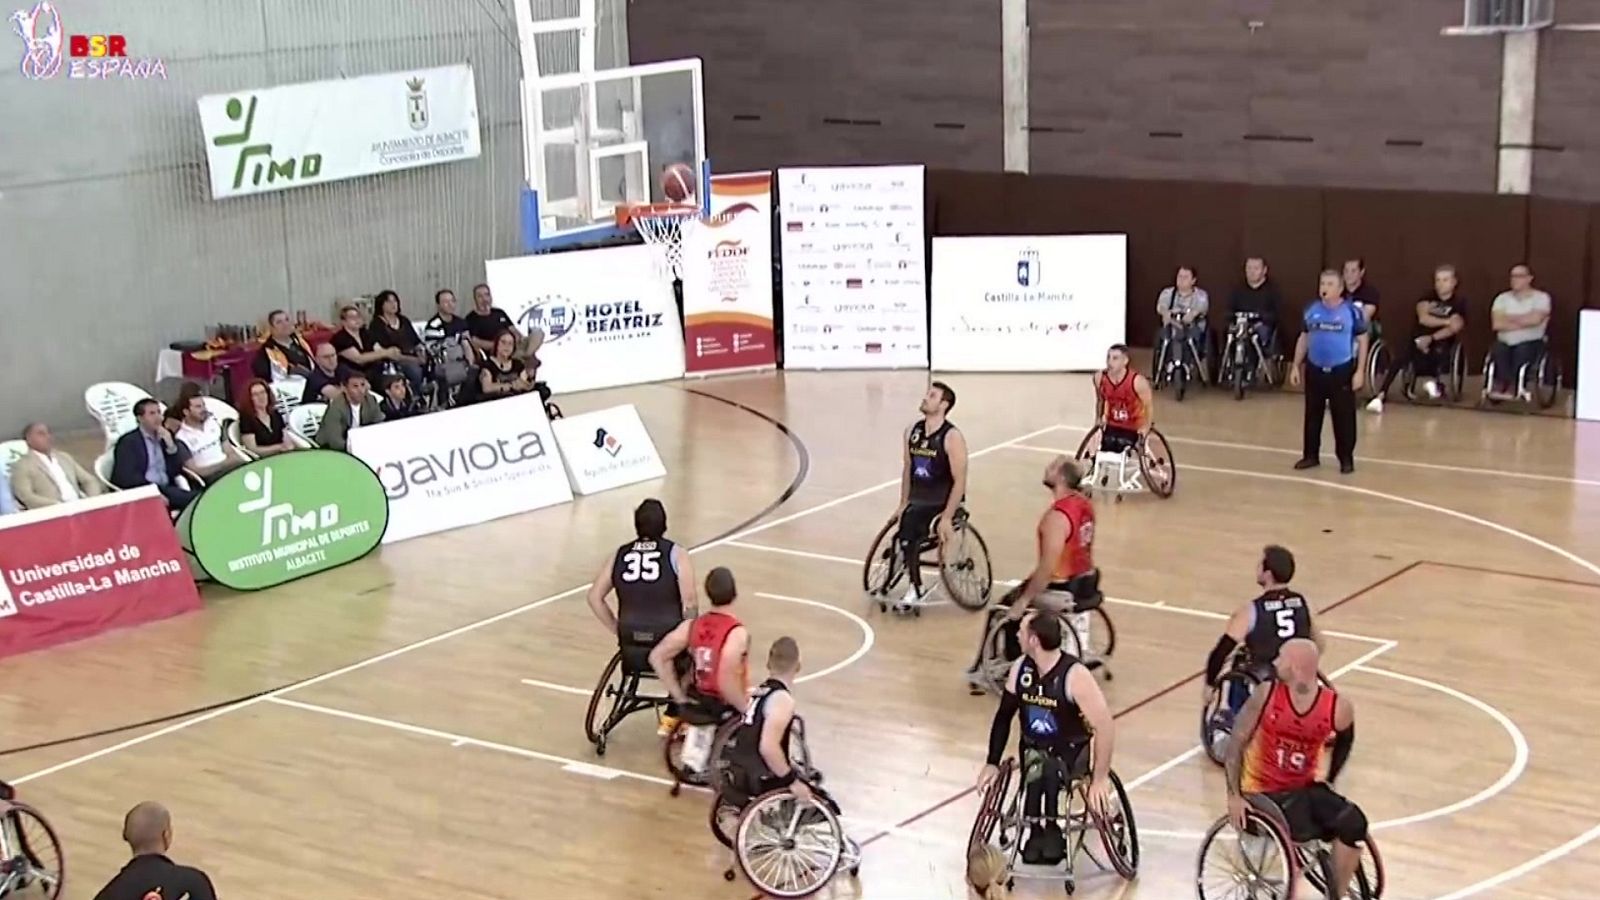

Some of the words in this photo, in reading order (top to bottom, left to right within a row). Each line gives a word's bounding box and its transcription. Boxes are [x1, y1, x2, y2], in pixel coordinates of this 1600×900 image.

[585, 300, 643, 319] HOTEL
[586, 312, 664, 335] BEATRIZ
[385, 431, 546, 500] gaviota
[228, 550, 274, 572] INSTITUTO
[272, 536, 319, 561] MUNICIPAL
[317, 533, 331, 547] DE
[330, 520, 370, 543] DEPORTES
[286, 549, 327, 572] ALBACETE
[9, 548, 116, 586] Universidad
[119, 543, 141, 561] de
[622, 551, 661, 583] 35
[19, 576, 113, 607] Castilla-La
[114, 558, 182, 586] Mancha
[1275, 608, 1296, 638] 5
[1276, 748, 1306, 771] 19
